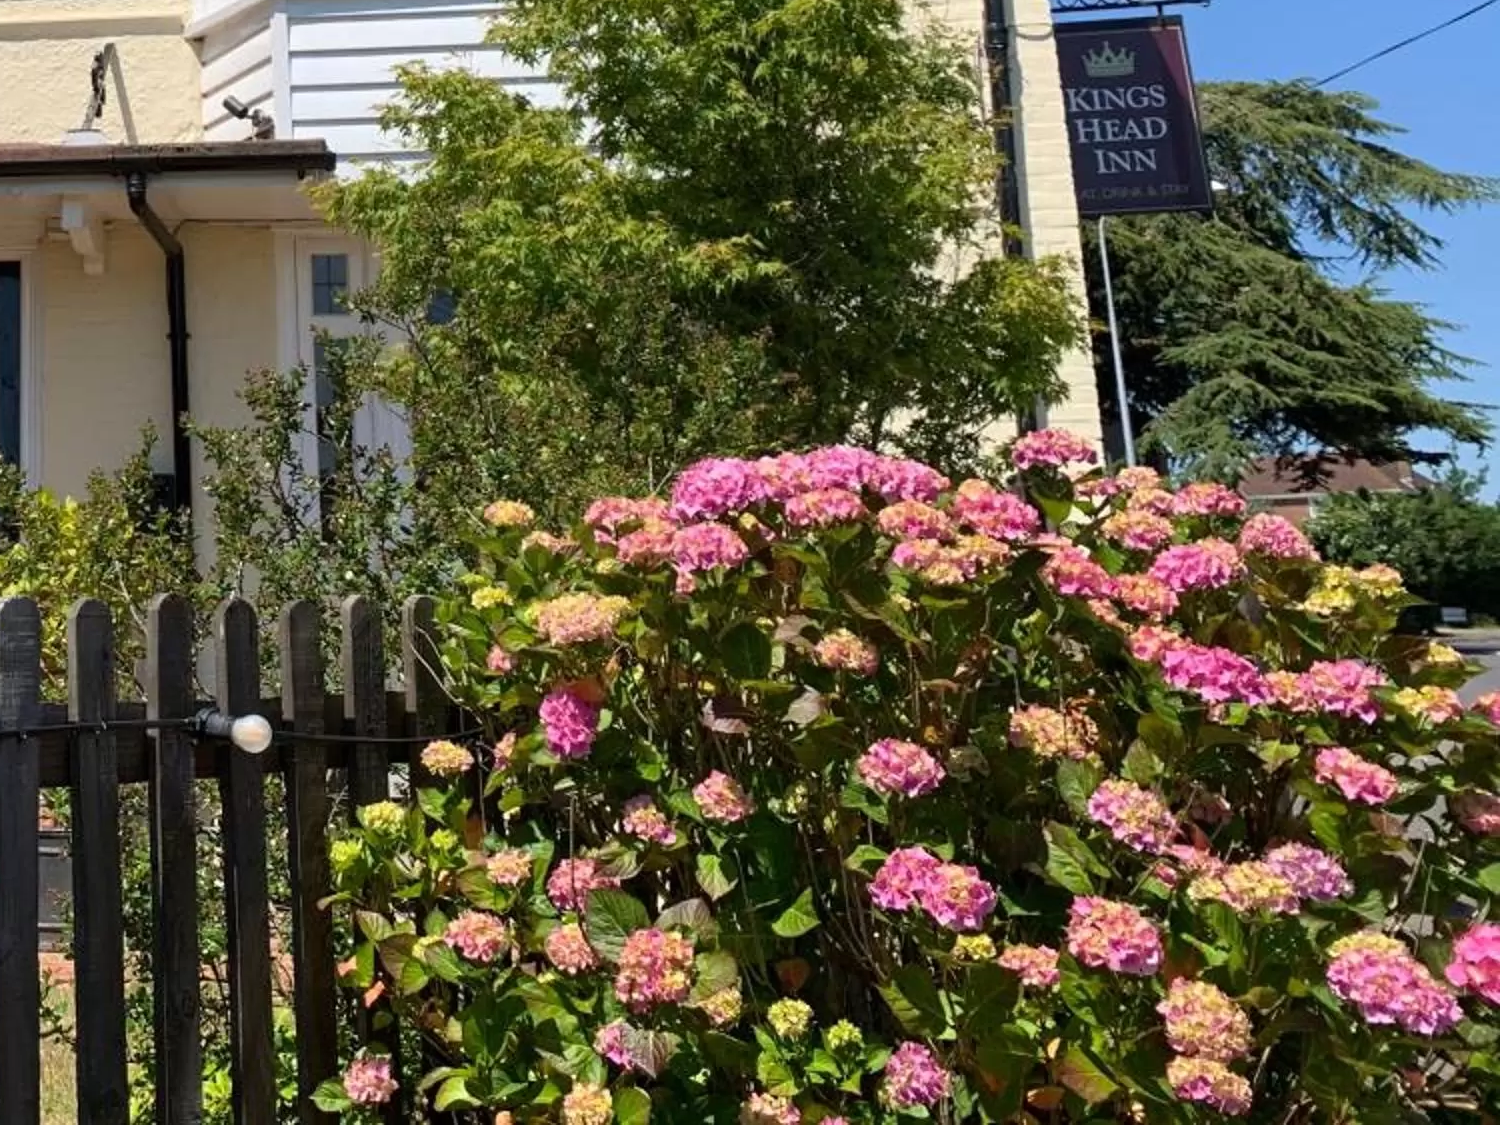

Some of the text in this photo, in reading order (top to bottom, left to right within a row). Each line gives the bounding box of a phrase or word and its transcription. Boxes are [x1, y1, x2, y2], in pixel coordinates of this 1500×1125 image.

[1067, 84, 1167, 112] KINGS
[1074, 116, 1168, 144] HEAD
[1094, 149, 1157, 174] INN
